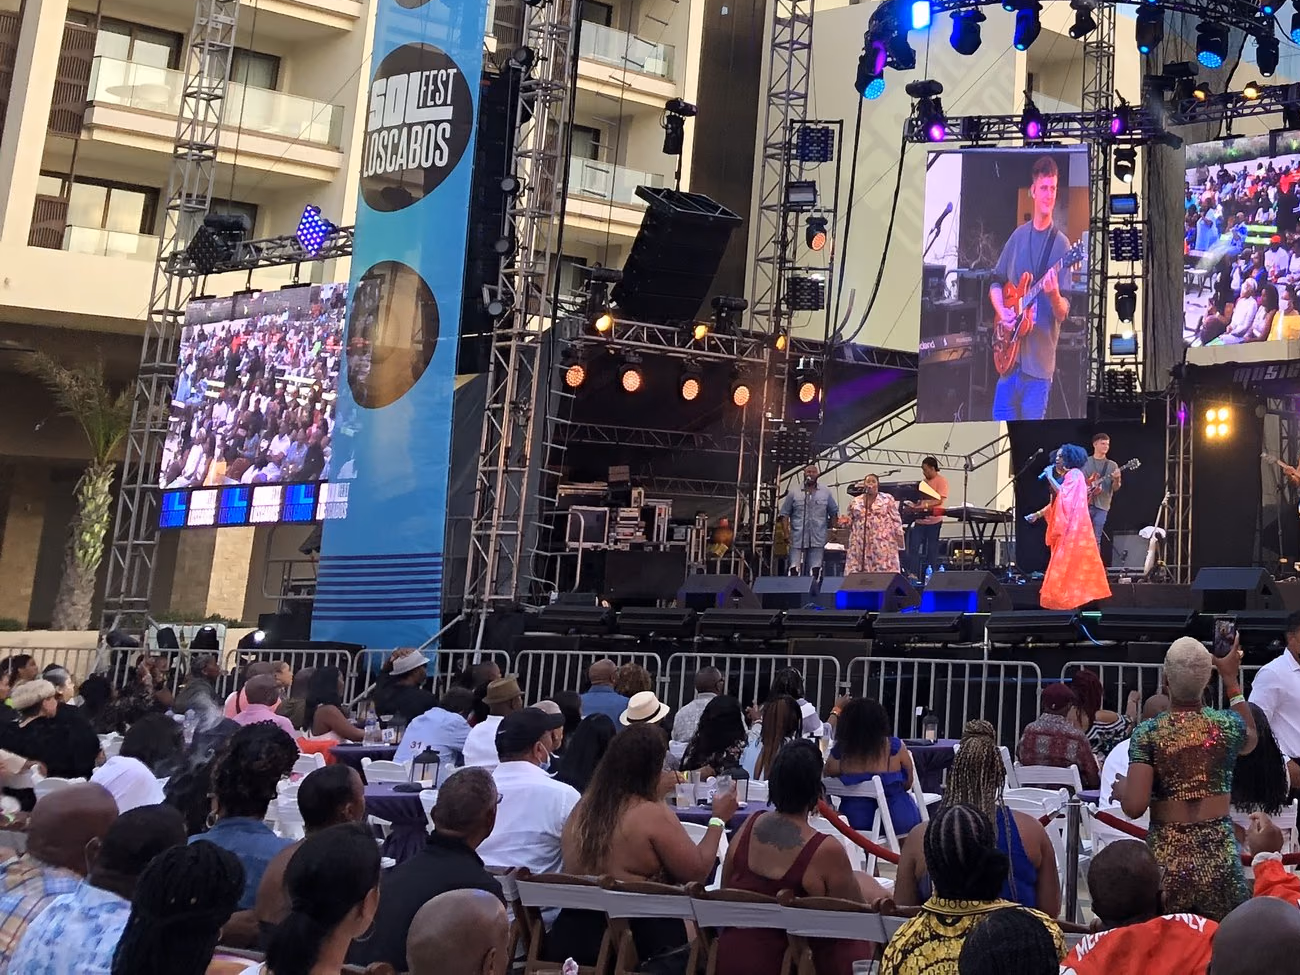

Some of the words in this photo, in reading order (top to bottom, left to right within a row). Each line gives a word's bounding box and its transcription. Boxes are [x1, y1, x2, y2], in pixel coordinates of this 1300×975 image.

[367, 71, 454, 132] SOL
[419, 68, 458, 108] FEST
[362, 122, 451, 178] LOSCABOS
